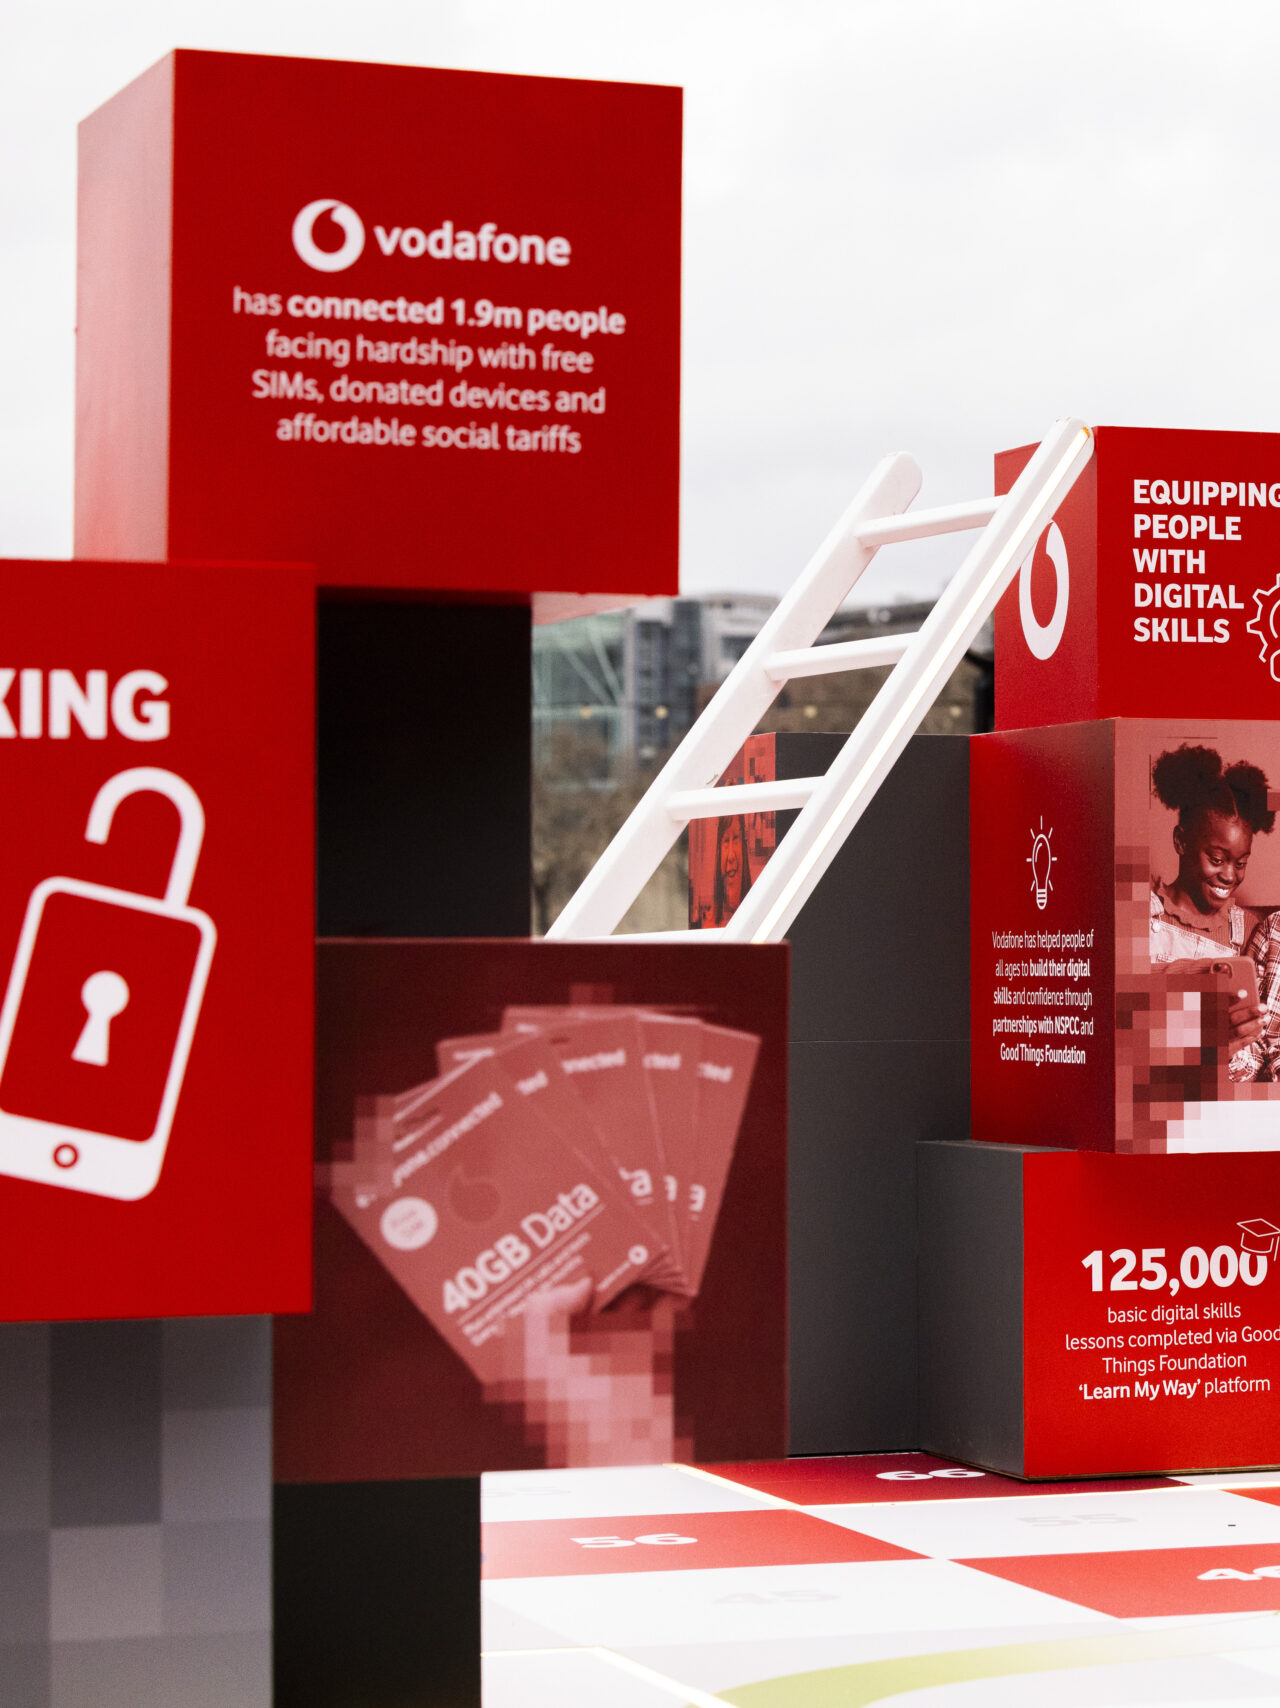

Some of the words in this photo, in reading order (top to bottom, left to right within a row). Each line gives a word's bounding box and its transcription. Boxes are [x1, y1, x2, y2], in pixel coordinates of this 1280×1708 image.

[373, 220, 572, 267] vodafone
[233, 286, 282, 316] has
[287, 294, 444, 325] connected
[450, 298, 522, 328] 1.9m
[527, 305, 626, 338] people
[266, 329, 350, 367] facing
[356, 333, 473, 372] hardship
[478, 340, 536, 370] with
[541, 343, 594, 373] free
[252, 369, 324, 403] SIMs,
[330, 374, 443, 406] donated
[450, 379, 551, 412] devices
[555, 387, 606, 414] and
[276, 412, 417, 447] affordable
[422, 421, 500, 450] social
[505, 424, 582, 453] tariffs
[1133, 513, 1242, 541] PEOPLE
[1133, 548, 1206, 574] WITH
[1134, 582, 1245, 609] DIGITAL
[1133, 617, 1230, 643] SKILLS
[992, 930, 1024, 949] Vodafone
[1024, 931, 1037, 948] has
[1037, 930, 1060, 952] helped
[1061, 929, 1086, 952] people
[1086, 928, 1094, 948] of
[995, 959, 1004, 977] all
[1004, 963, 1021, 981] ages
[1021, 961, 1029, 977] to
[1029, 958, 1048, 977] build
[1049, 958, 1066, 977] their
[1067, 958, 1091, 981] digital
[993, 987, 1012, 1005] skills
[1013, 987, 1026, 1005] and
[1026, 987, 1064, 1006] confidence
[1064, 987, 1093, 1010] through
[992, 1016, 1037, 1037] partnerships
[1038, 1015, 1054, 1034] with
[1054, 1016, 1080, 1035] NSPCC
[1080, 1017, 1094, 1036] and
[1000, 1043, 1019, 1061] Good
[1019, 1043, 1044, 1066] Things
[1045, 1043, 1086, 1065] Foundation
[443, 1233, 531, 1314] 40GB
[521, 1183, 599, 1248] Data
[1081, 1245, 1268, 1297] 125,000
[1107, 1306, 1147, 1323] basic
[1151, 1303, 1199, 1324] digital
[1203, 1302, 1241, 1319] skills
[1065, 1333, 1124, 1350] lessons
[1128, 1328, 1212, 1350] completed
[1216, 1328, 1237, 1344] via
[1102, 1356, 1155, 1376] Things
[1159, 1352, 1247, 1372] Foundation
[1134, 1381, 1160, 1401] My
[1204, 1377, 1270, 1398] platform
[875, 1468, 987, 1481] 66
[570, 1532, 698, 1549] 56
